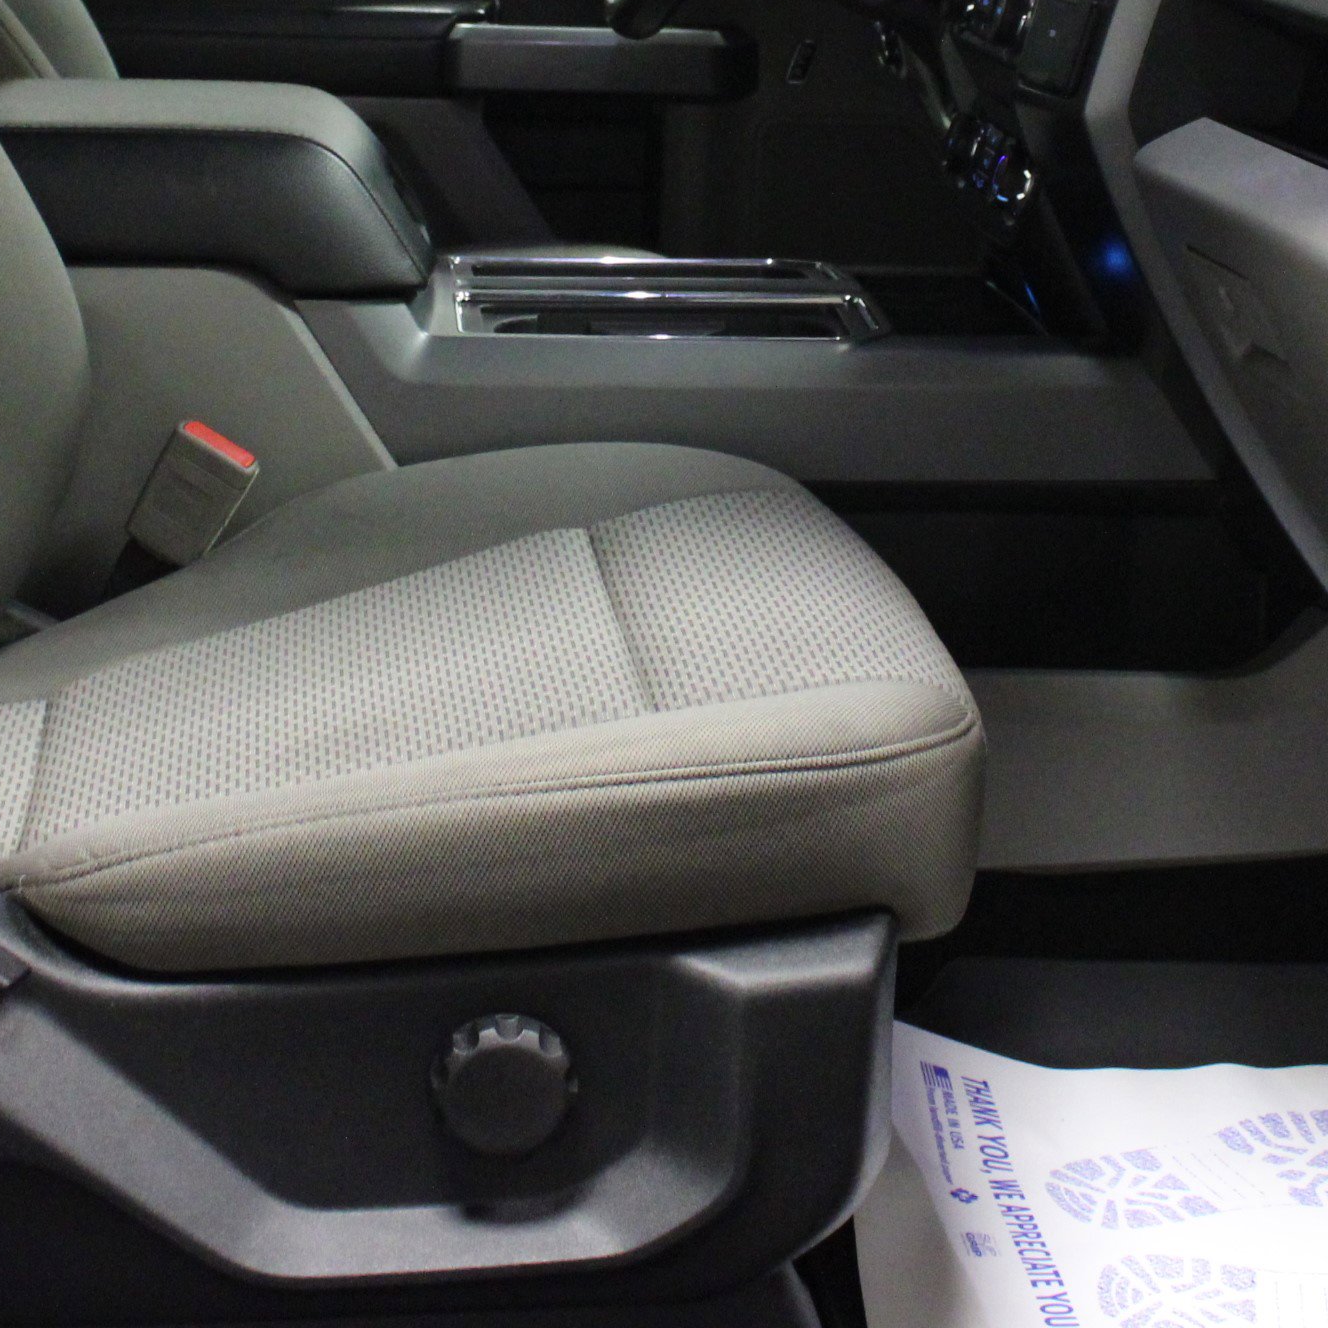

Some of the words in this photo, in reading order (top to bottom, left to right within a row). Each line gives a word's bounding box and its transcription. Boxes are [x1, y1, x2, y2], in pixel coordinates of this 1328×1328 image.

[960, 1076, 1003, 1130] THANK
[950, 1131, 964, 1149] USA
[977, 1135, 1014, 1174] YOU,
[988, 1179, 1026, 1201] WE
[997, 1203, 1064, 1288] APPRECIATE
[1036, 1291, 1080, 1327] YOU
